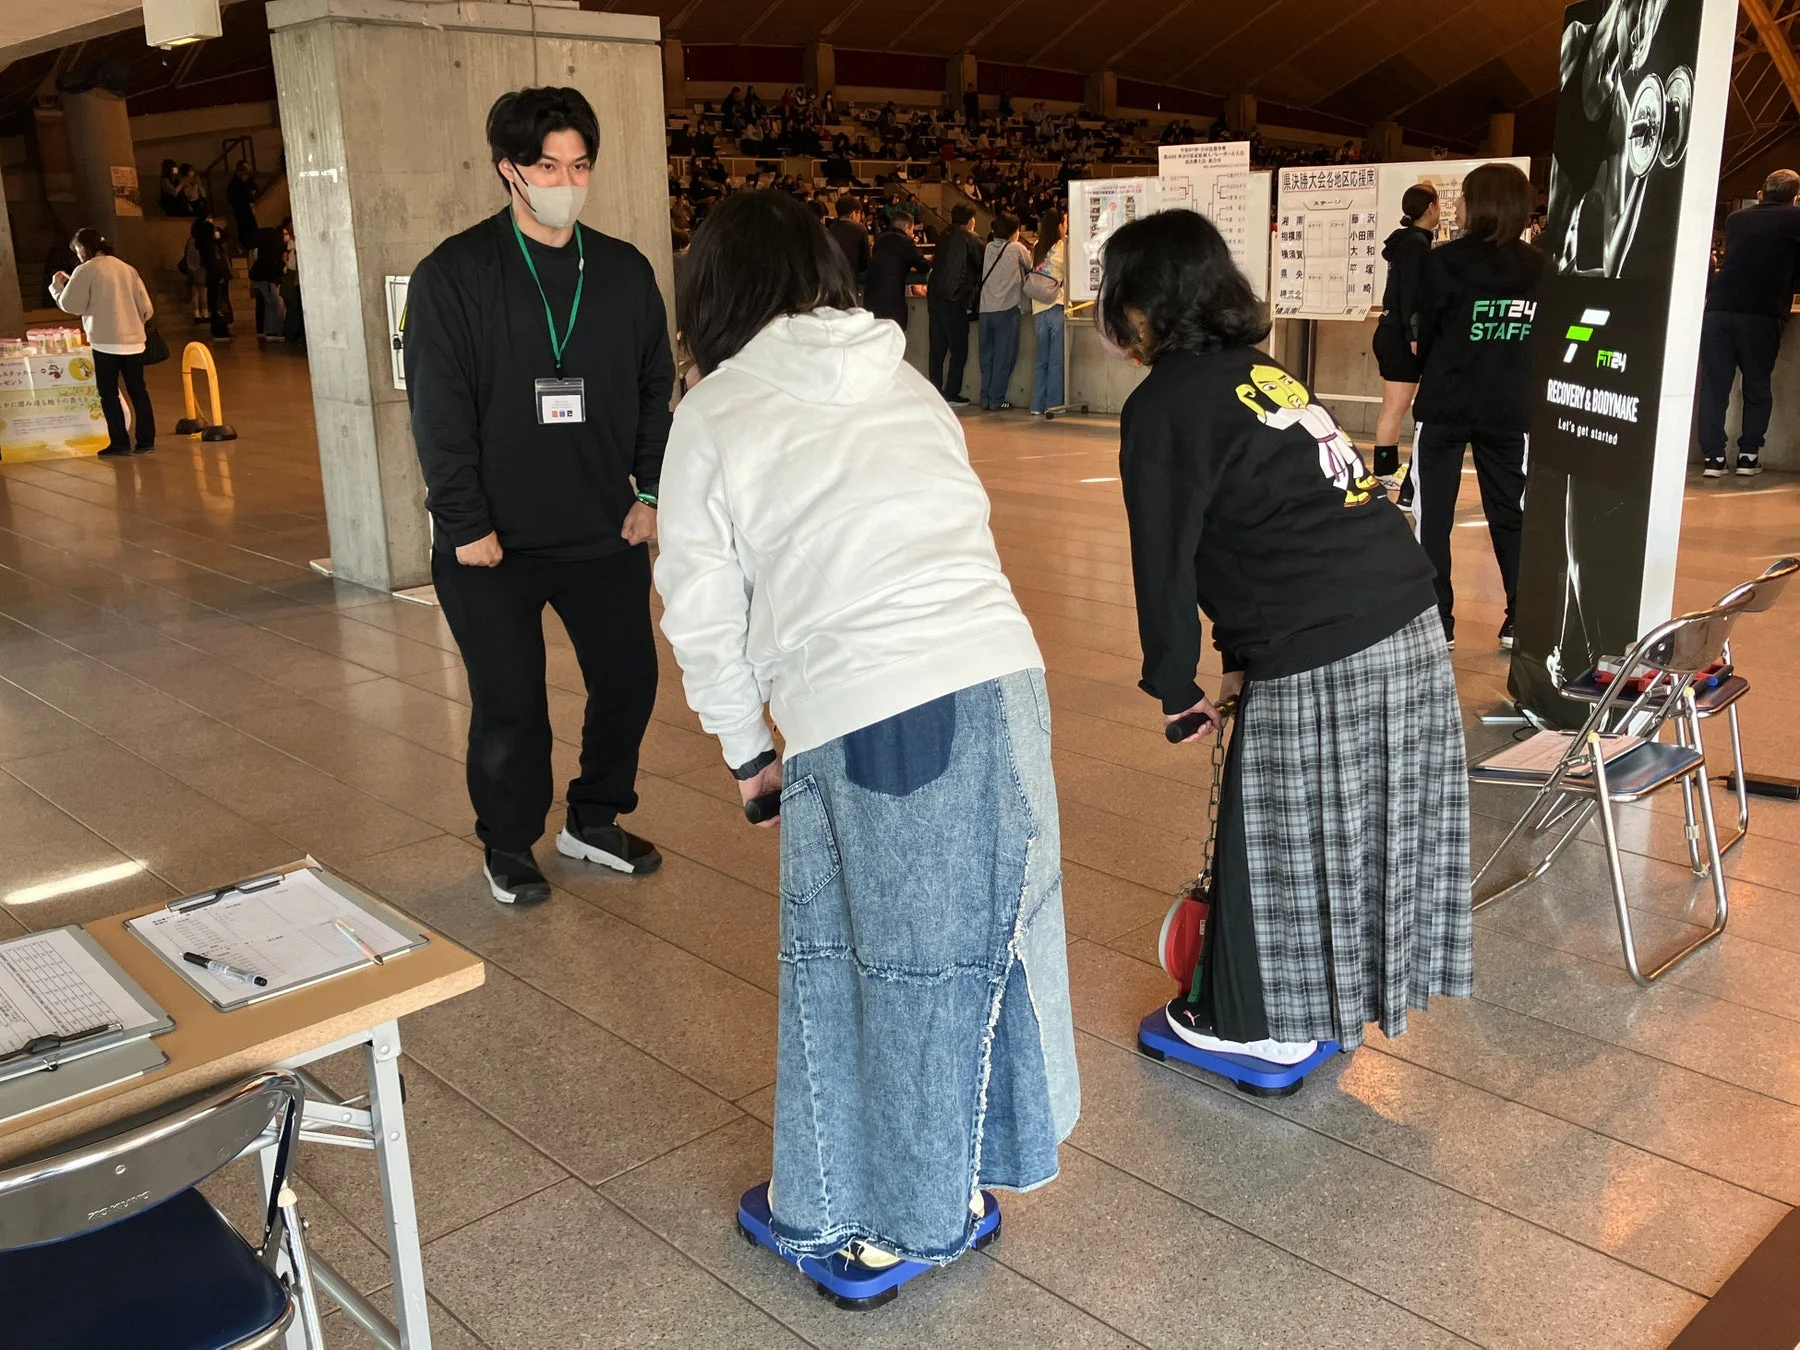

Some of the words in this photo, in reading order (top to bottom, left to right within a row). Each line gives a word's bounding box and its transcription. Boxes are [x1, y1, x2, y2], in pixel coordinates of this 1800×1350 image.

[1283, 169, 1375, 190] 県決勝大会各地区応援席
[1351, 213, 1375, 224] 藤沢
[1281, 231, 1303, 241] 相模原
[1350, 230, 1375, 241] 小田原
[1281, 250, 1303, 260] 横須賀
[1350, 246, 1375, 256] 大和
[1350, 264, 1374, 275] 平塚
[1348, 283, 1371, 293] 川崎
[1469, 322, 1532, 342] STAFF
[1546, 378, 1586, 410] RECOVERY
[1585, 389, 1592, 412] &
[1591, 388, 1640, 423] BODYMAKE
[1558, 417, 1575, 433] Let's
[1577, 425, 1589, 438] get
[1590, 427, 1618, 446] started
